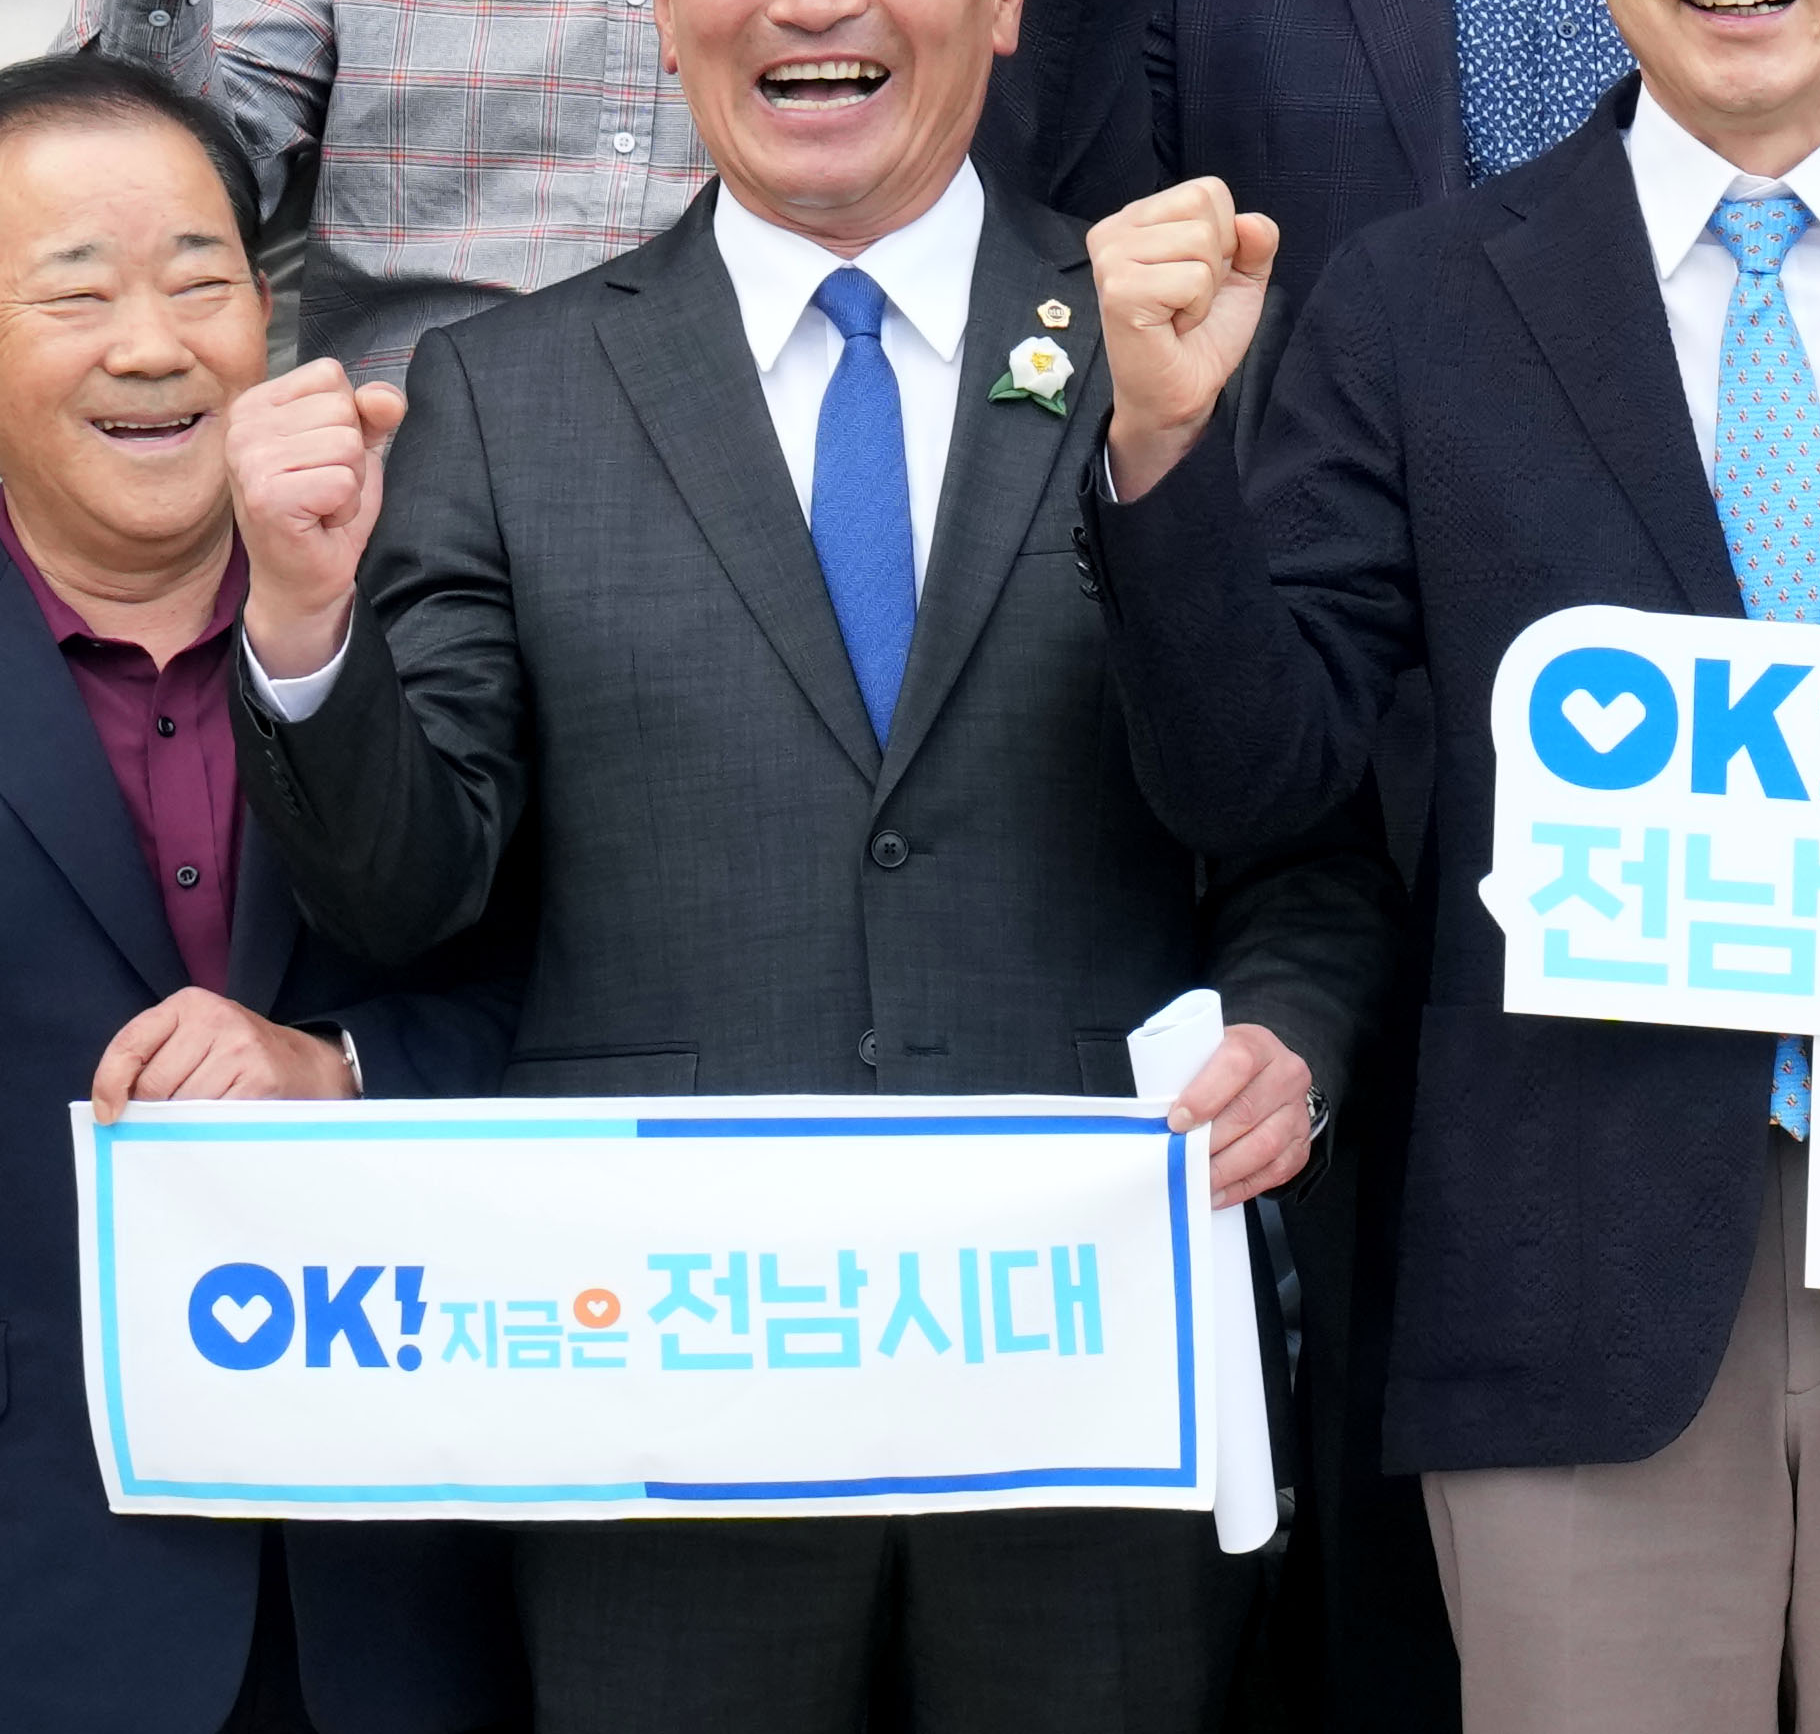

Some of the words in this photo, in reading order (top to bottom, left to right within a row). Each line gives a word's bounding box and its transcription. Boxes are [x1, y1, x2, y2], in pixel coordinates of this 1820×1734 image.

[187, 1262, 428, 1373] OK!
[440, 1288, 630, 1370] 지금은
[648, 1242, 1105, 1371] 전남시대
